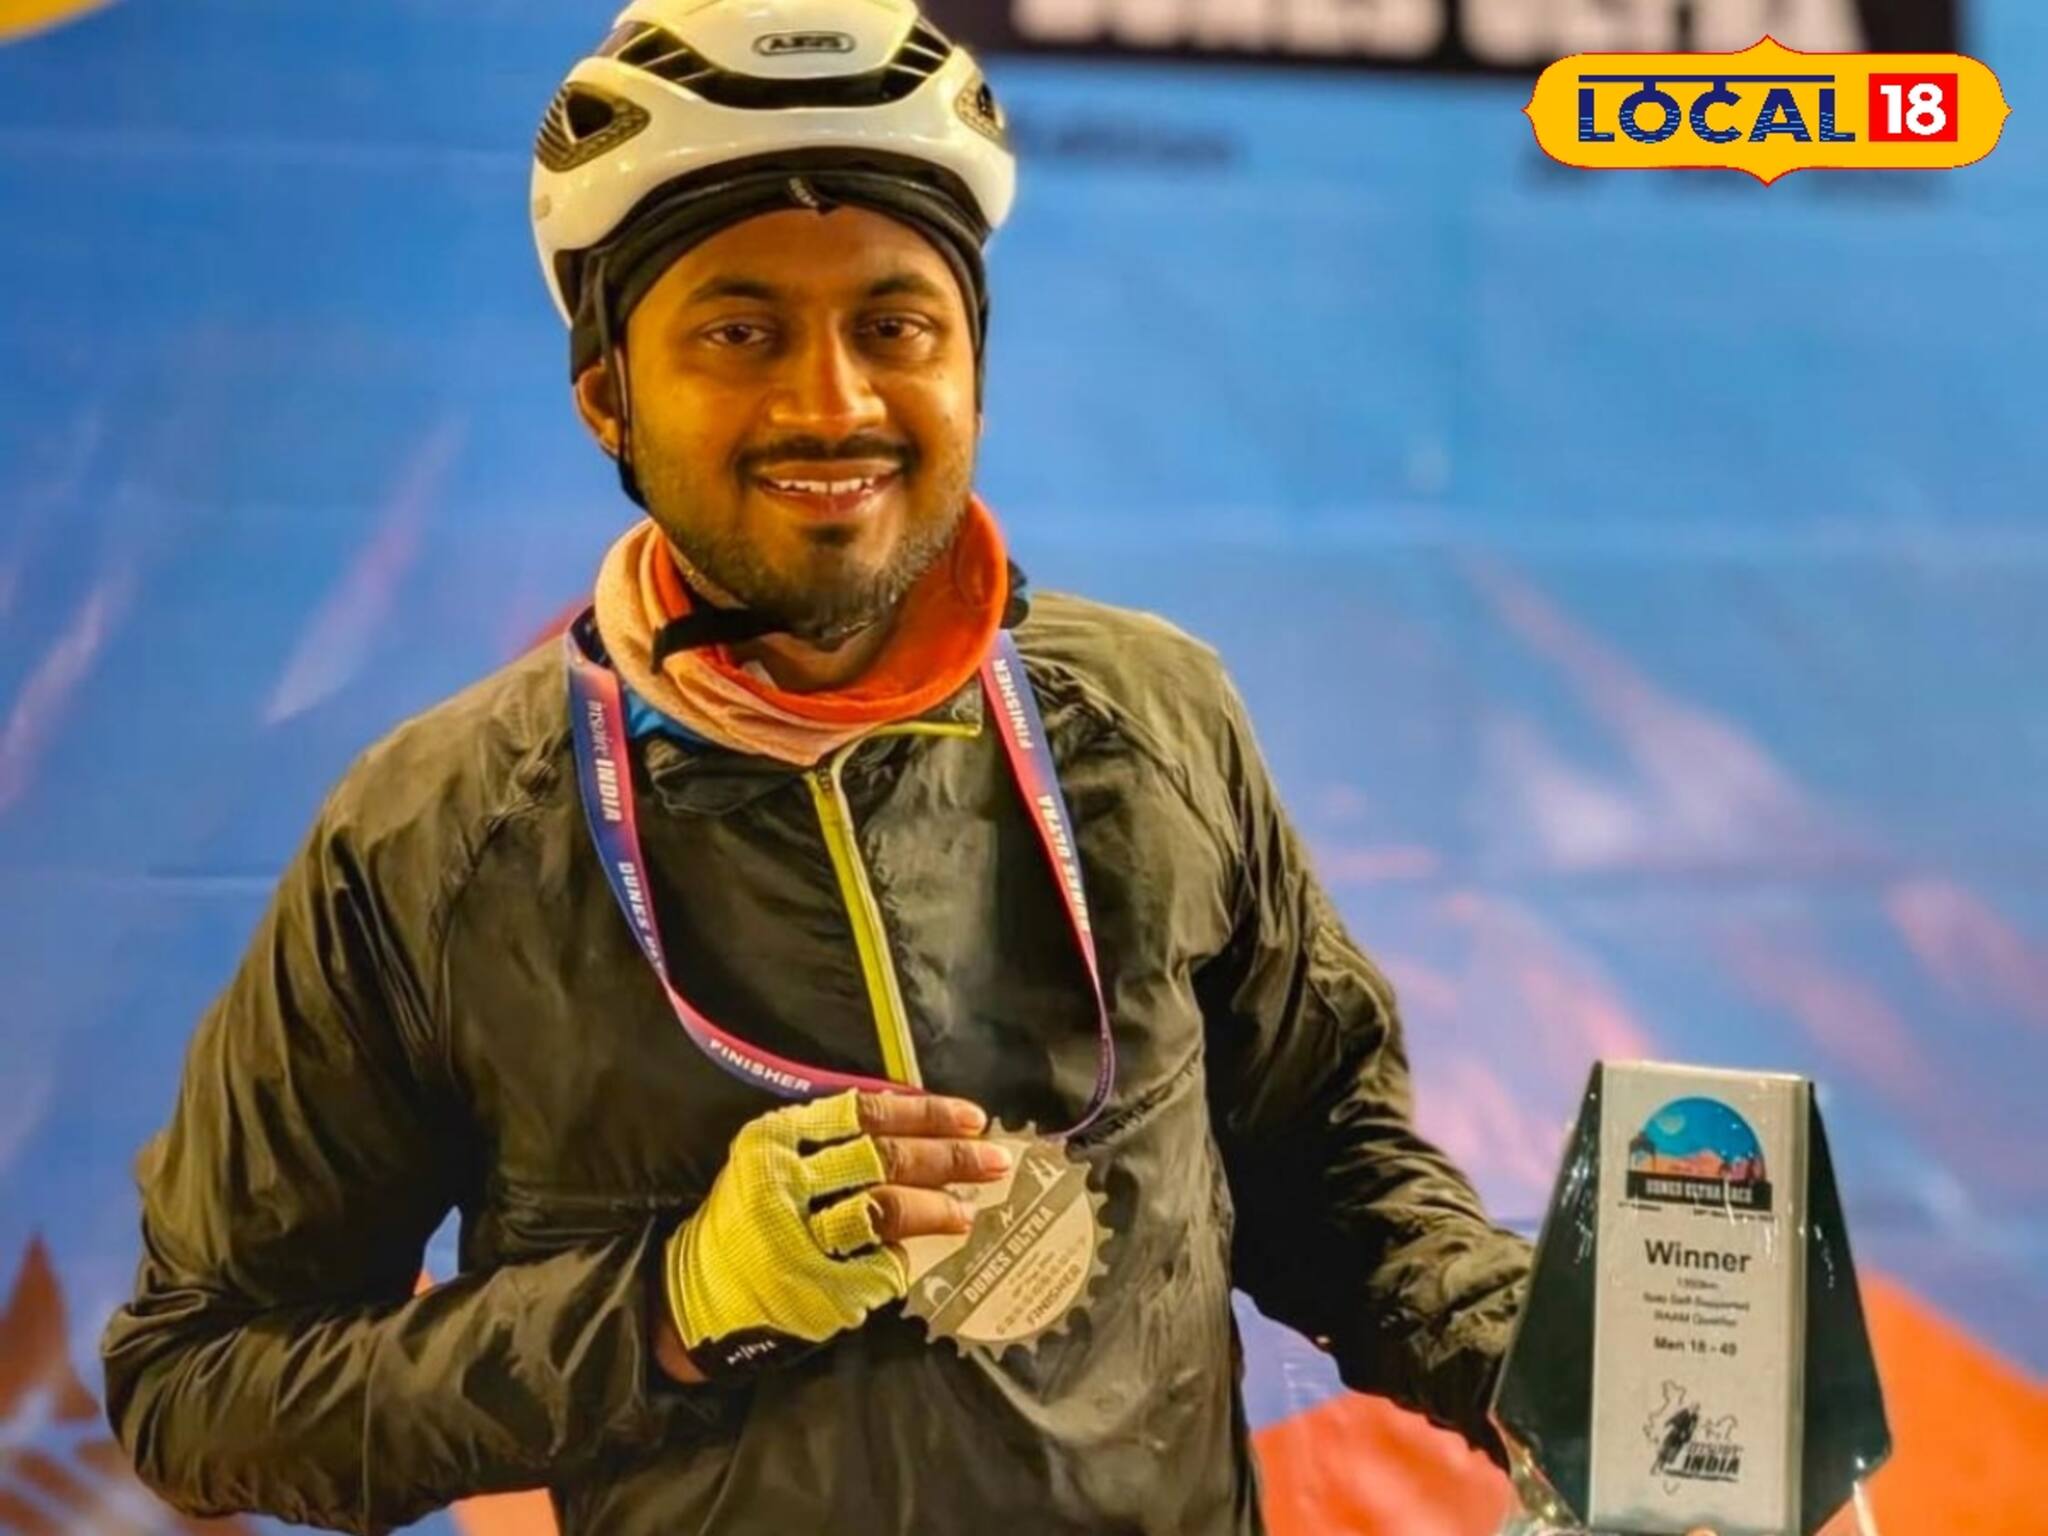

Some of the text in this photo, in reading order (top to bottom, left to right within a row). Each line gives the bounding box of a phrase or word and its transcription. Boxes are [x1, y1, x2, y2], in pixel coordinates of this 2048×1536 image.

[992, 658, 1034, 750] FINISHER
[596, 758, 623, 822] INDIA
[1037, 794, 1071, 858] ULTRA
[618, 861, 651, 931] DUNES
[710, 1038, 812, 1093] FINISHER
[963, 1253, 1013, 1305] DUNES
[1006, 1205, 1056, 1259] ULTRA
[1645, 1239, 1752, 1273] Winner
[1027, 1263, 1082, 1325] FINISHER
[1654, 1336, 1685, 1351] Men
[1683, 1453, 1739, 1475] INDIA
